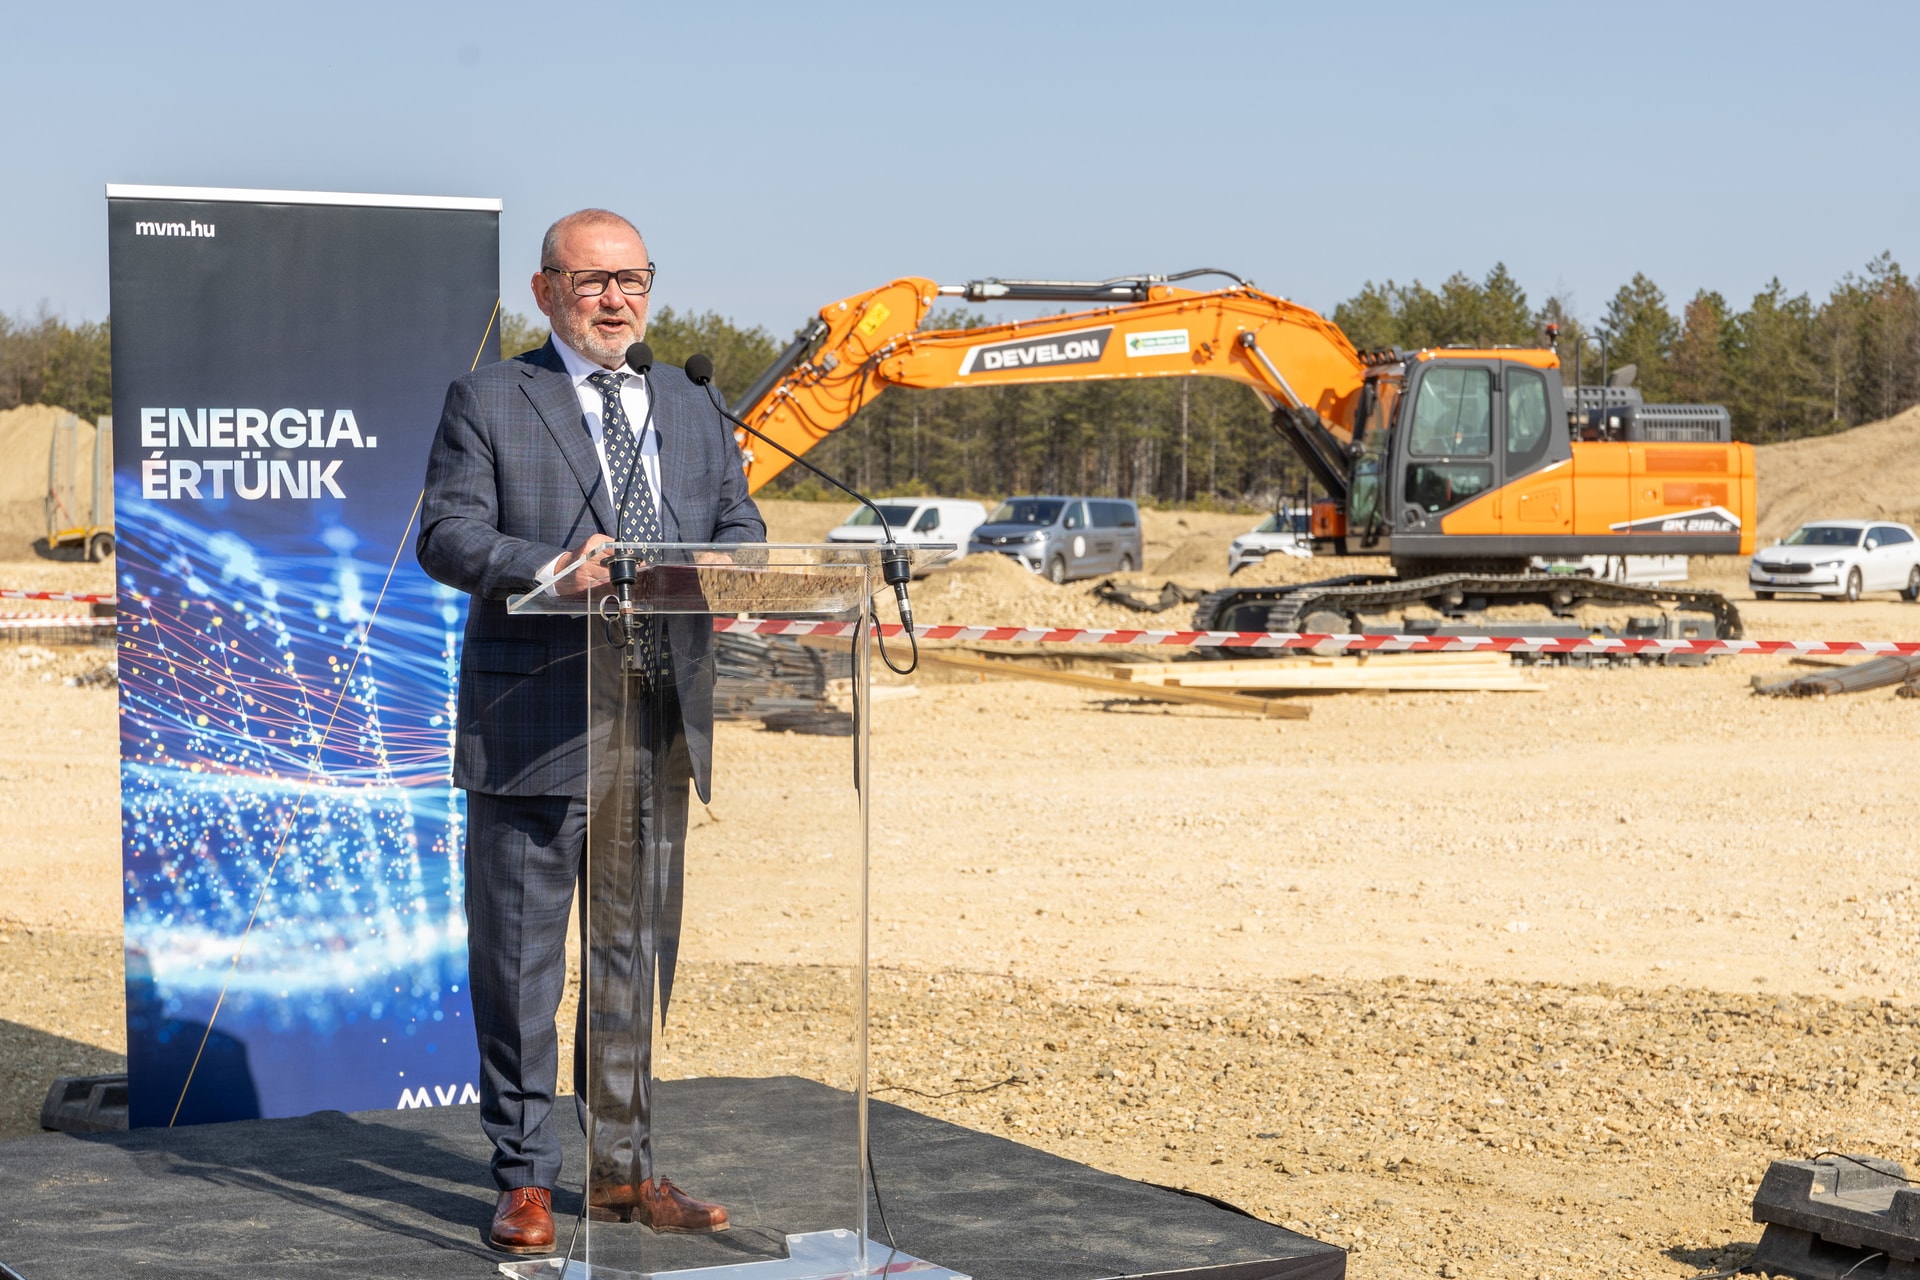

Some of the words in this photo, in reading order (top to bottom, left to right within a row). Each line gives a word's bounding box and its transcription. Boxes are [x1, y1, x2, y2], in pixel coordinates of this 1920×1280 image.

[135, 219, 215, 238] mvm.hu
[983, 338, 1100, 370] DEVELON
[140, 407, 378, 449] ENERGIA.
[141, 450, 347, 500] ÉRTÜNK
